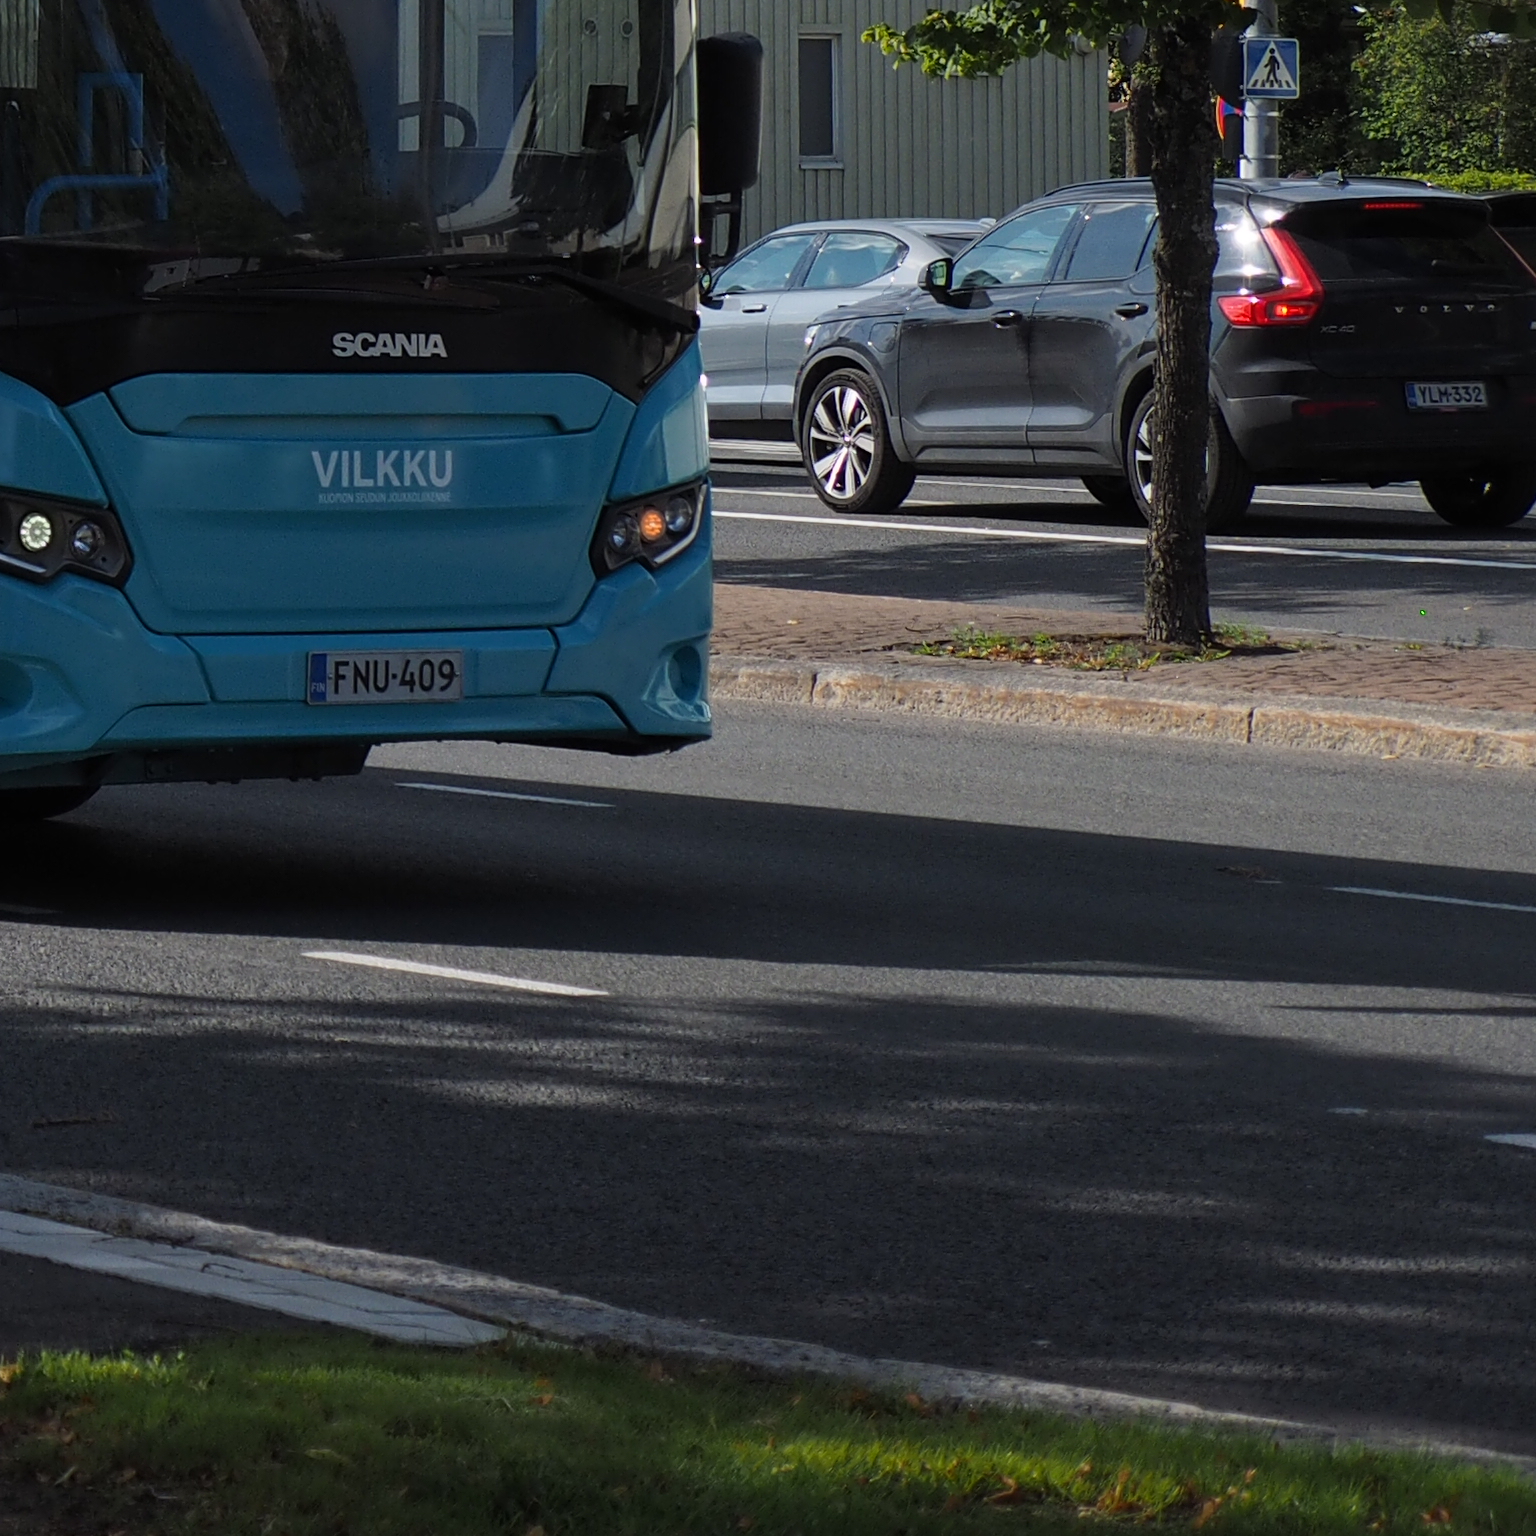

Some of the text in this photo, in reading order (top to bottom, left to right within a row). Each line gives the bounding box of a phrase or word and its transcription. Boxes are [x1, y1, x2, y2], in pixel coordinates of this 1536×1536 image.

[1394, 304, 1495, 313] VOLVO
[332, 332, 448, 358] SCANIA
[1418, 385, 1484, 404] YLM-332
[311, 450, 453, 488] VILKKU
[333, 658, 455, 695] FNU-409
[311, 682, 326, 694] FIN
